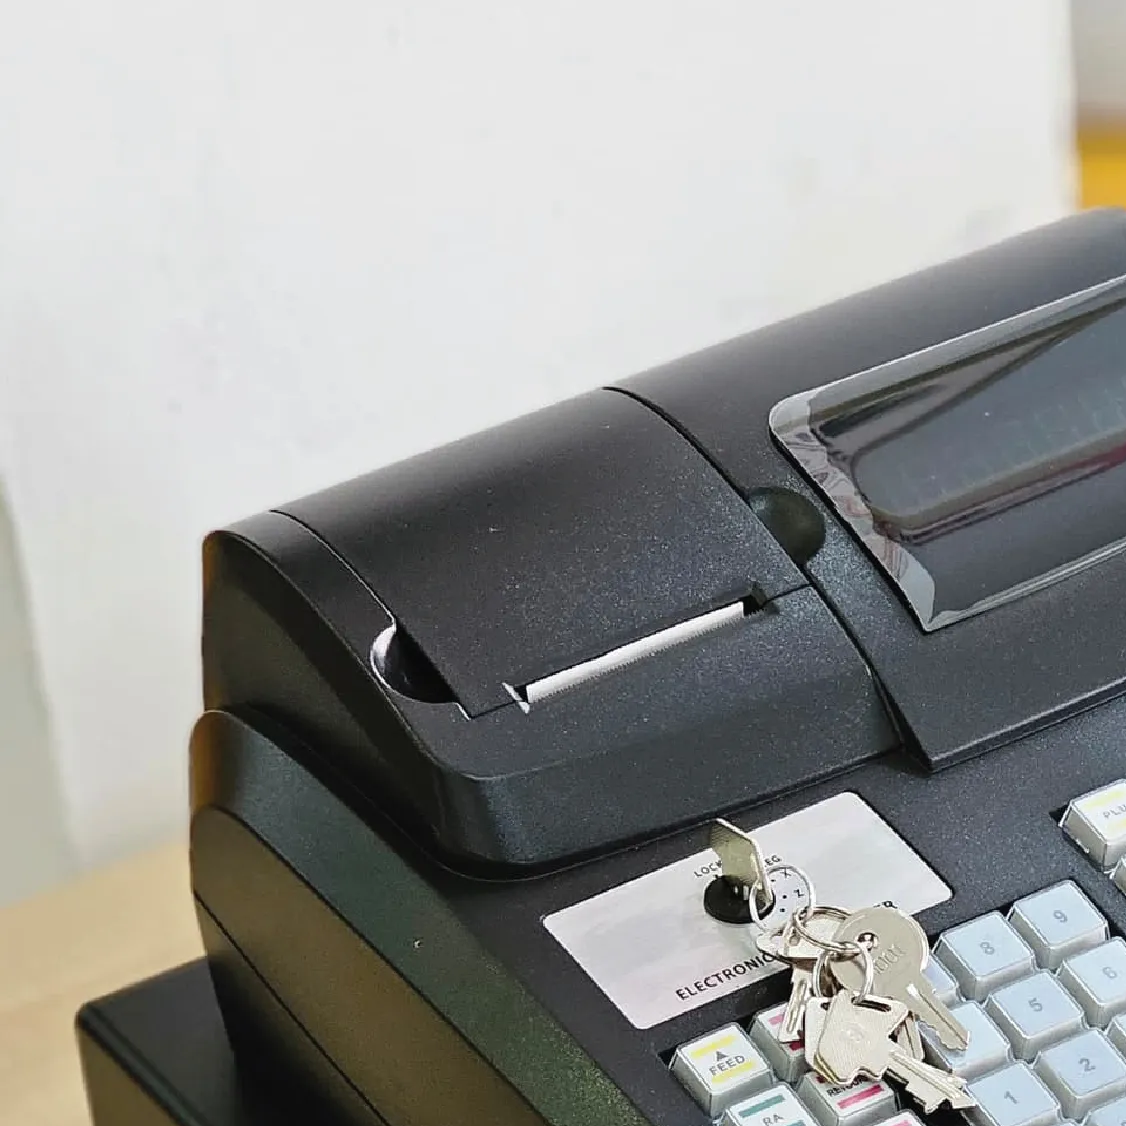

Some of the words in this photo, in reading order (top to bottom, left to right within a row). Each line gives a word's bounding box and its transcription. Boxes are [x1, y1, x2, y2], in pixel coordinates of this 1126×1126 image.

[1053, 910, 1068, 924] 9
[980, 941, 995, 955] 8
[1102, 966, 1117, 980] 6
[1028, 998, 1042, 1012] 5
[709, 1054, 745, 1075] FEED
[1079, 1057, 1096, 1072] 2
[1004, 1090, 1018, 1104] 1
[763, 1113, 784, 1126] RA
